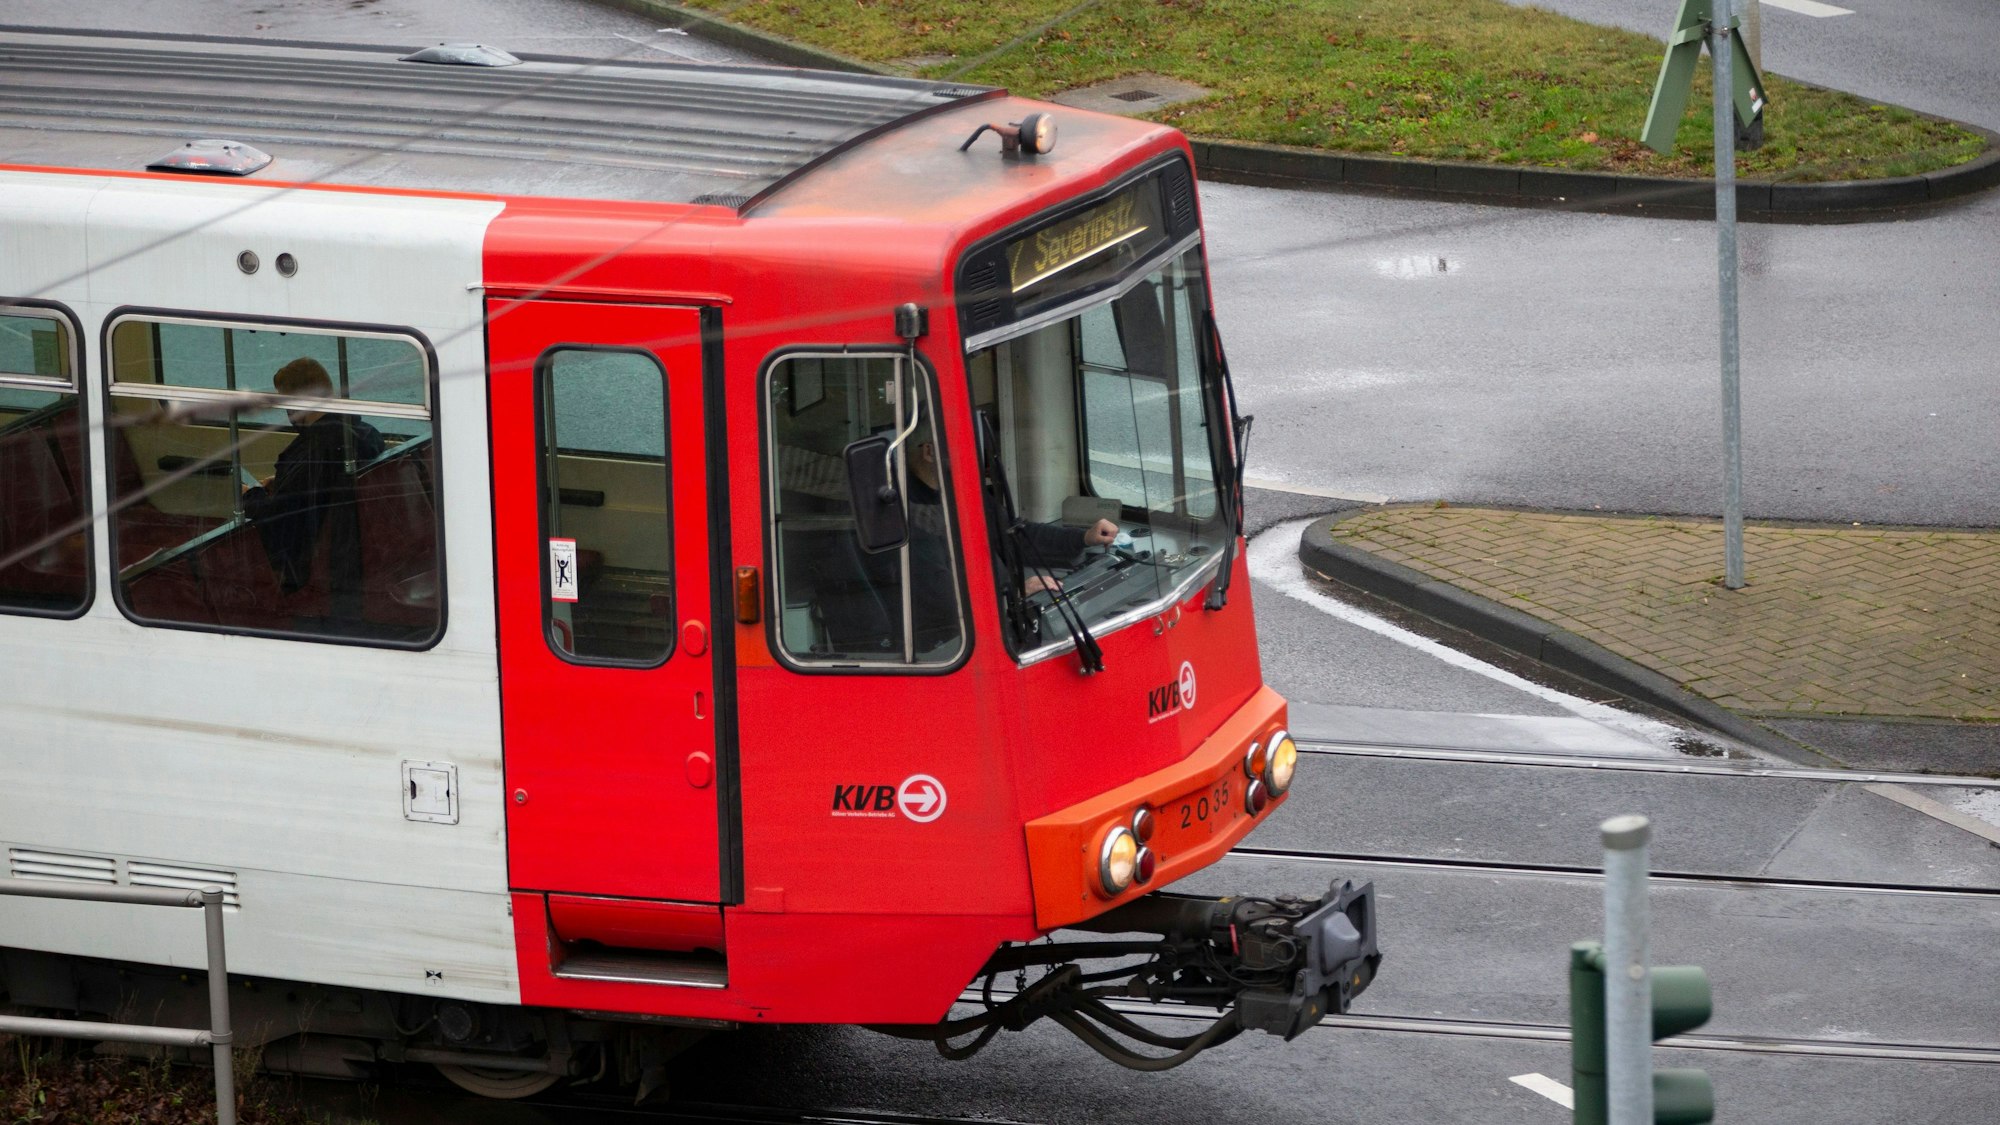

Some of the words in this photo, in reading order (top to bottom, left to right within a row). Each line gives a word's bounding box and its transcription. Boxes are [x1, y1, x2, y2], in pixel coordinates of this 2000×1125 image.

[1149, 680, 1180, 718] KVB
[832, 785, 896, 811] KVB
[1181, 781, 1229, 829] 2035
